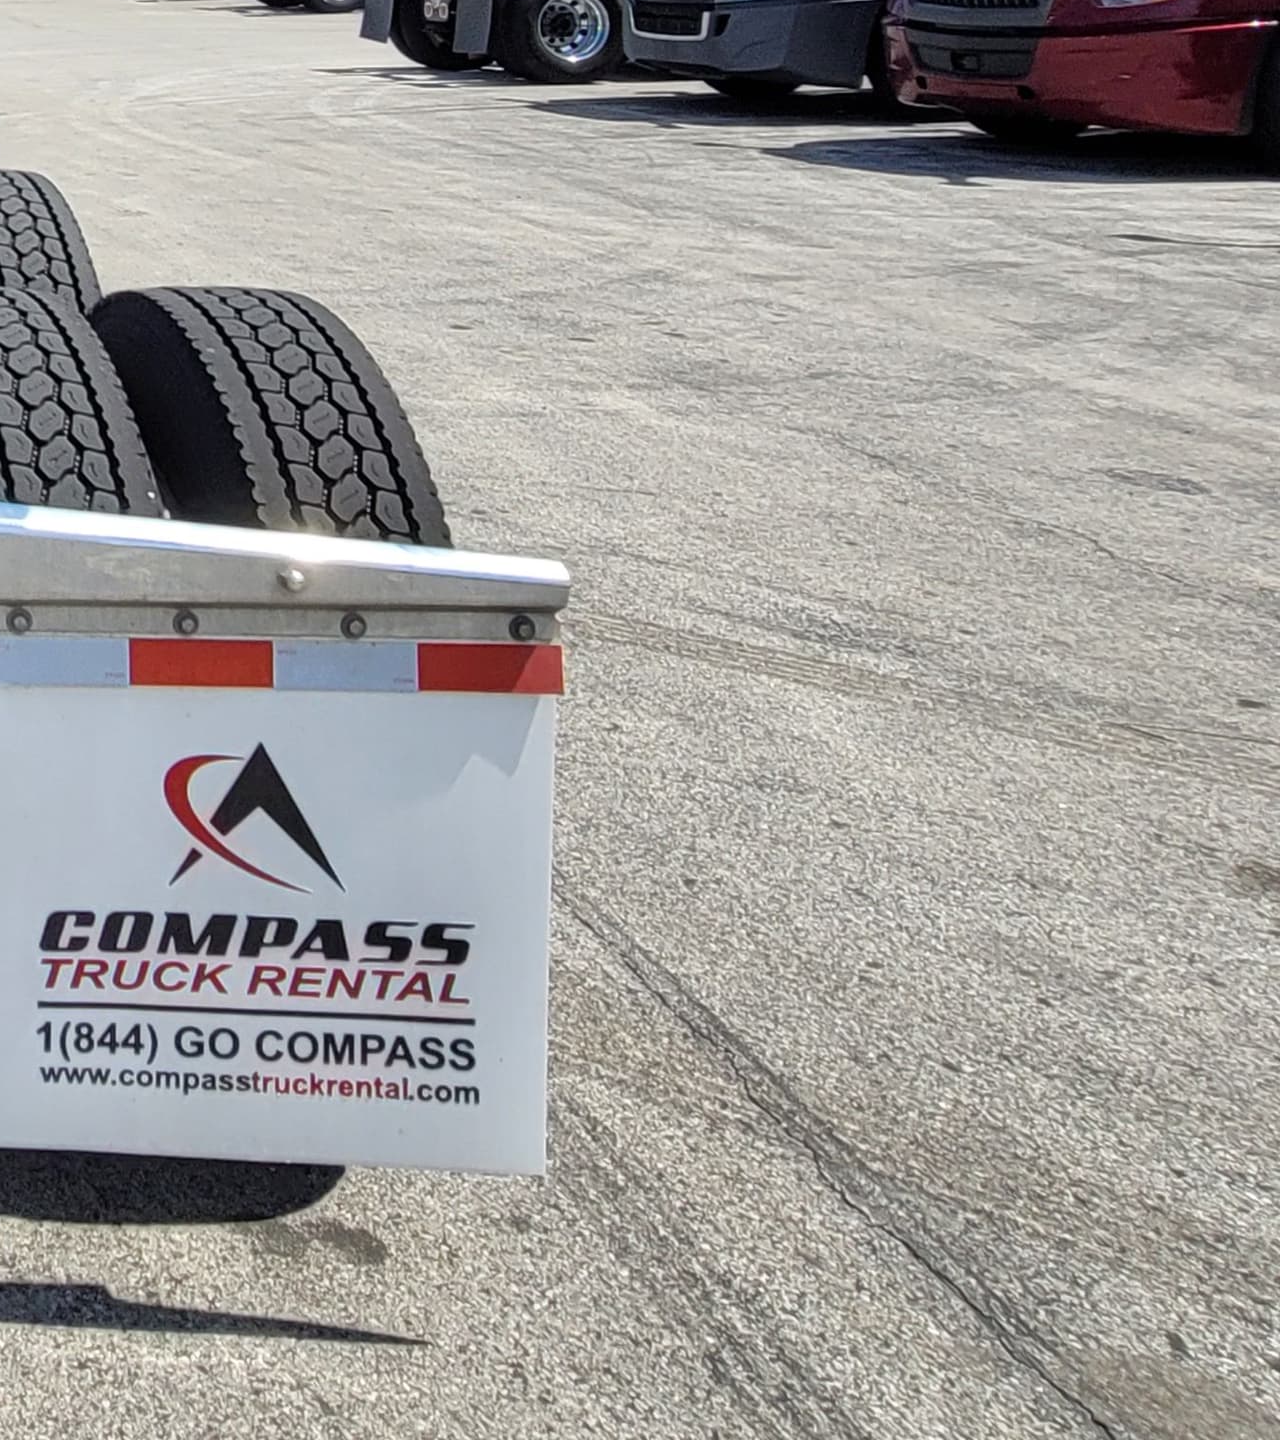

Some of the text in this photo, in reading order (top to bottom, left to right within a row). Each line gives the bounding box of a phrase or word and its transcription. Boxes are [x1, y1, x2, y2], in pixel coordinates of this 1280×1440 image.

[39, 911, 475, 966] COMPASS
[41, 959, 470, 1004] TRUCK RENTAL
[37, 1022, 476, 1071] 1(844) GO COMPASS
[40, 1067, 480, 1105] www.compasstruckrental.com
